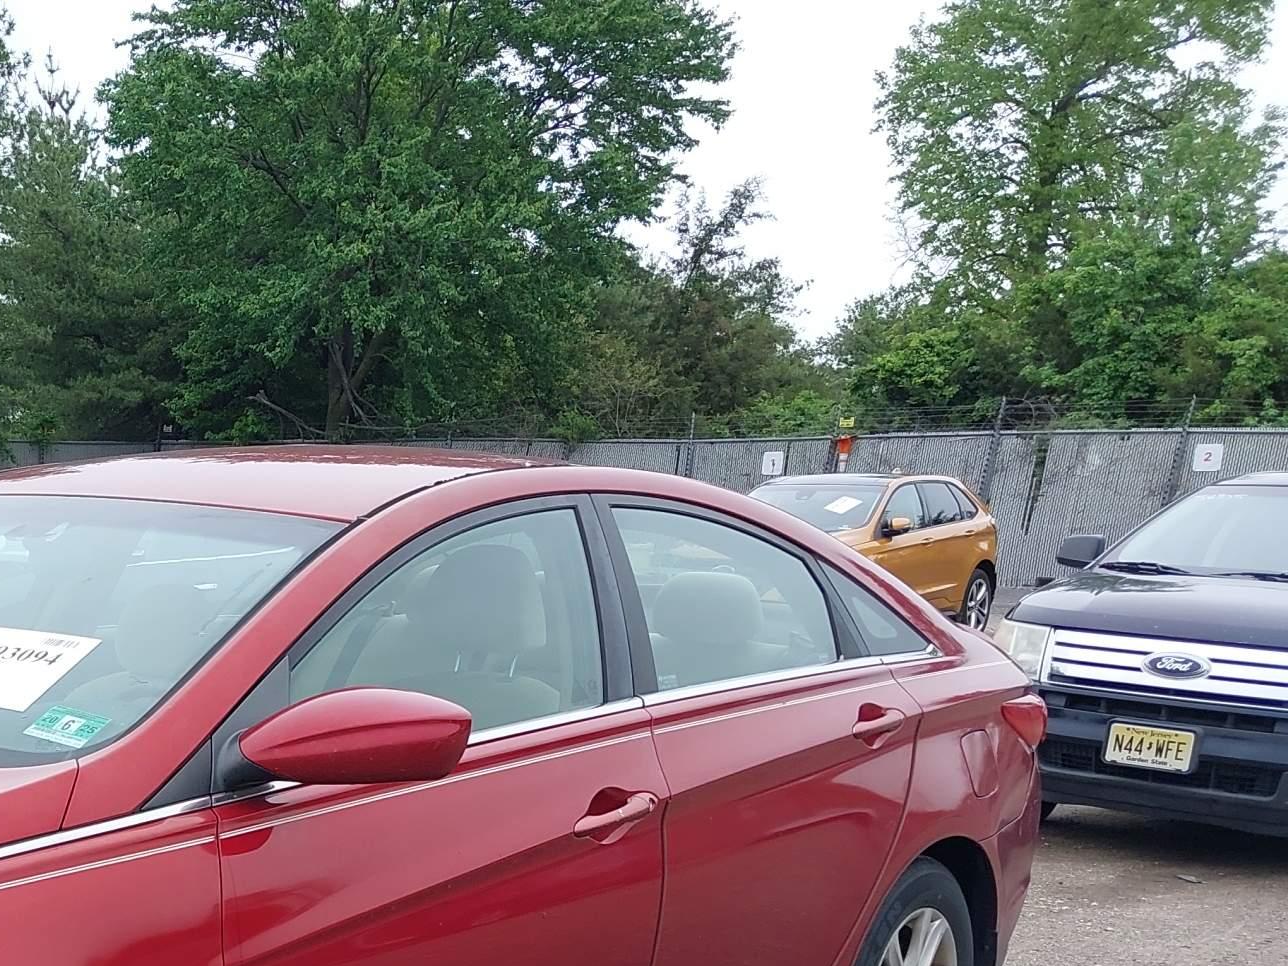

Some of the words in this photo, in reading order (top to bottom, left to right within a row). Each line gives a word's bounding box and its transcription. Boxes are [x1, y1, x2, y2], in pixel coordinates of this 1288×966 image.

[1204, 451, 1213, 462] 2
[1156, 656, 1193, 671] Ford
[42, 714, 59, 724] 20
[62, 719, 73, 731] 6
[79, 724, 98, 734] 25
